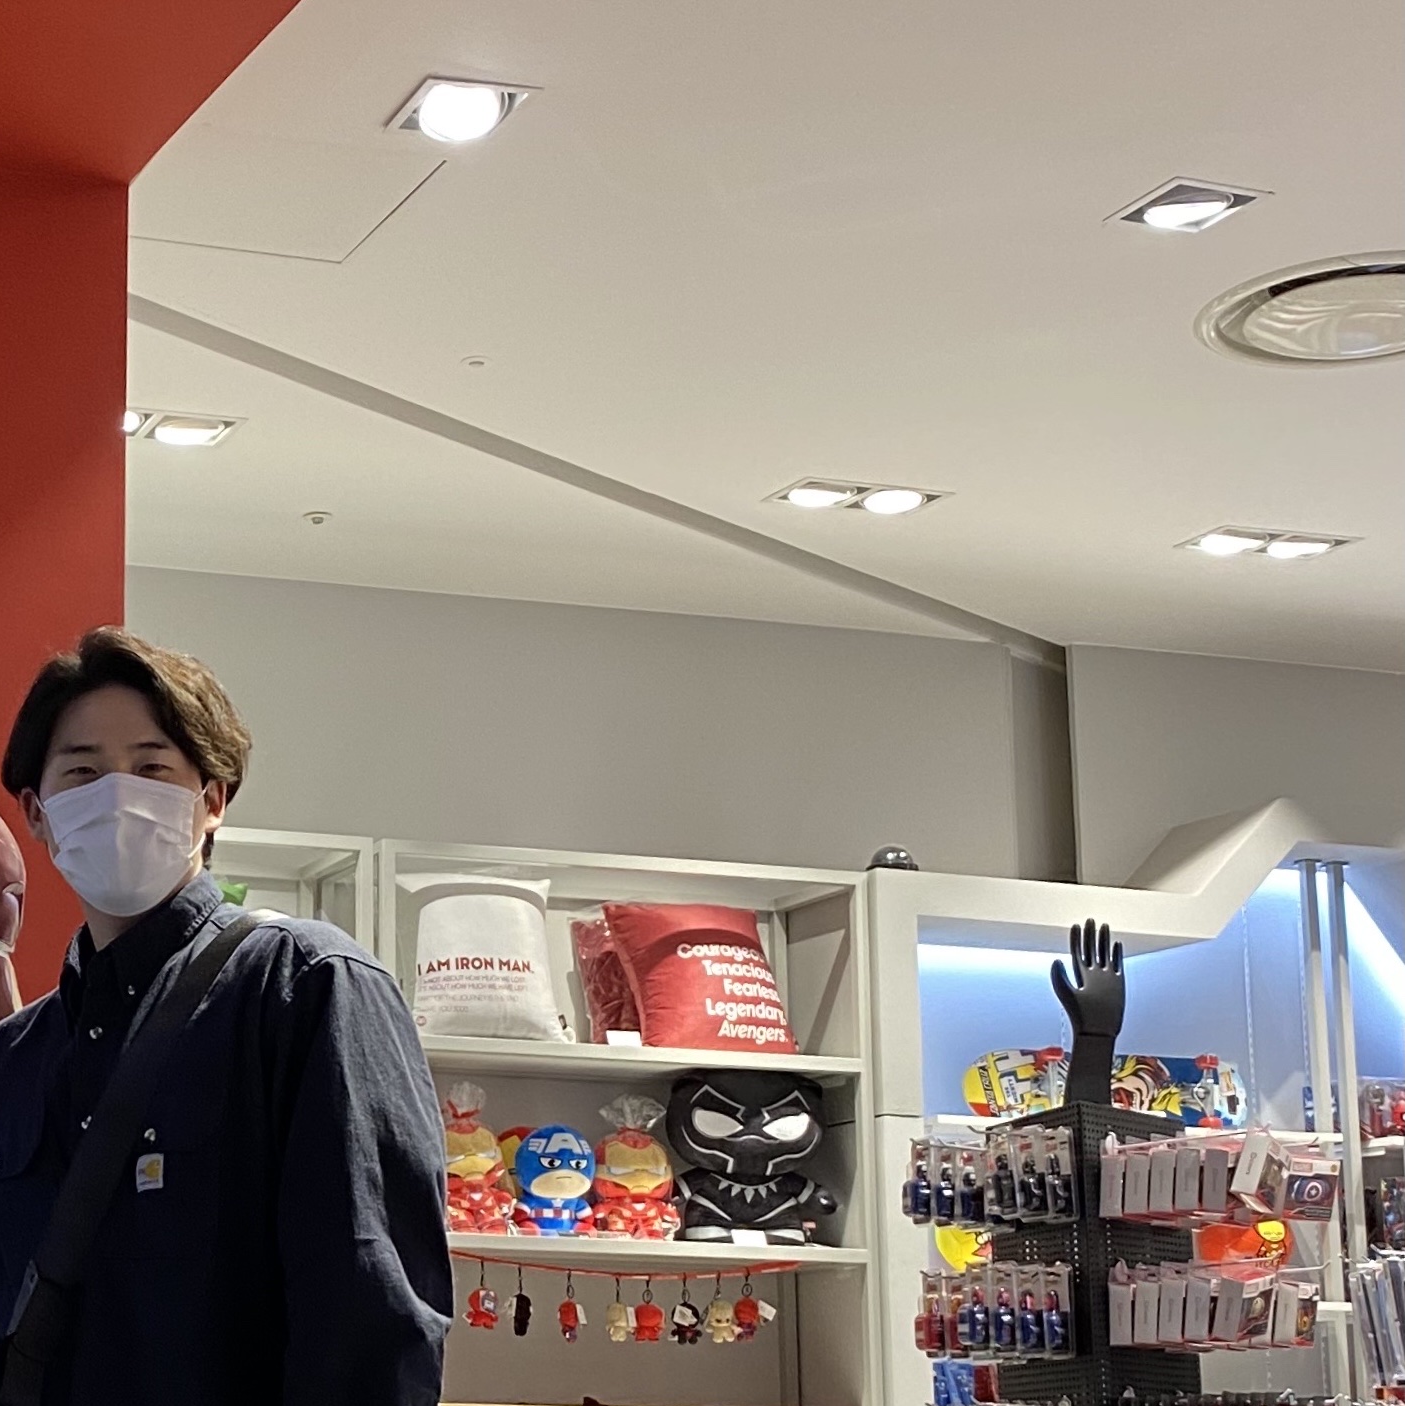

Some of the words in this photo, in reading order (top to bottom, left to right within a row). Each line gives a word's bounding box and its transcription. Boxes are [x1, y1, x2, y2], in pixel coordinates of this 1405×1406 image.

[417, 963, 422, 976] I
[426, 958, 451, 974] AM
[455, 957, 494, 970] IRON
